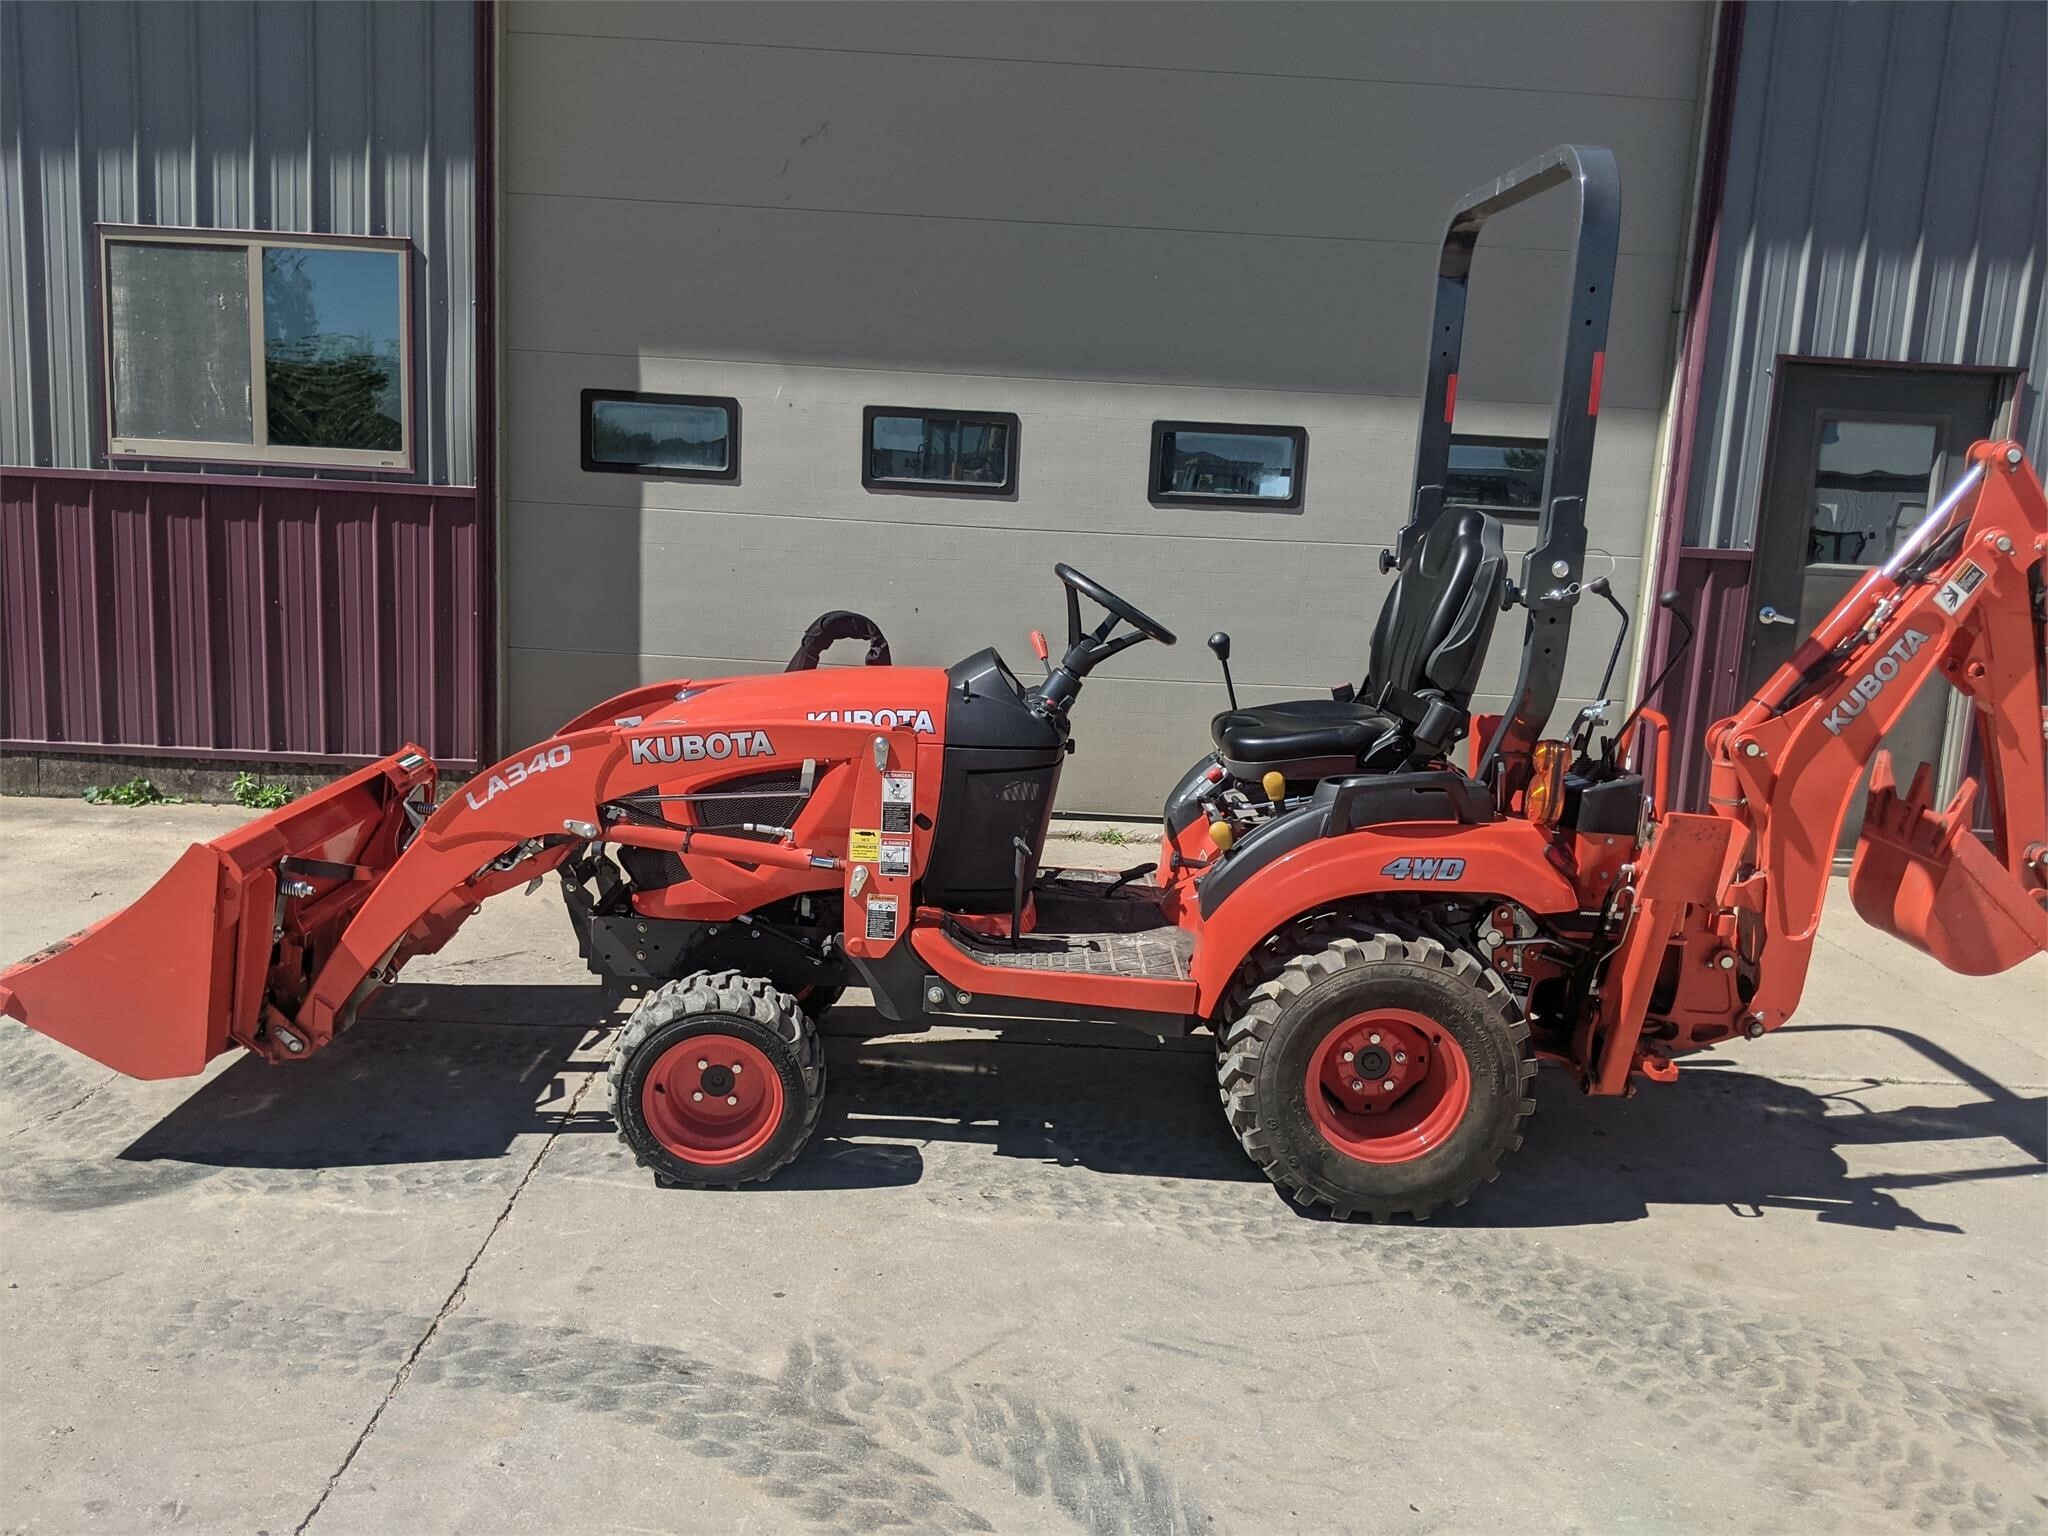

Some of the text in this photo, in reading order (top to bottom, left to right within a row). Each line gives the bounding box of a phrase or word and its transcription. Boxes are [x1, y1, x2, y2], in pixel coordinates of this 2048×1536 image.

[1822, 628, 1930, 736] KUBOTA
[631, 730, 776, 765] KUBOTA
[465, 744, 572, 810] LA340
[1380, 856, 1466, 881] 4WD
